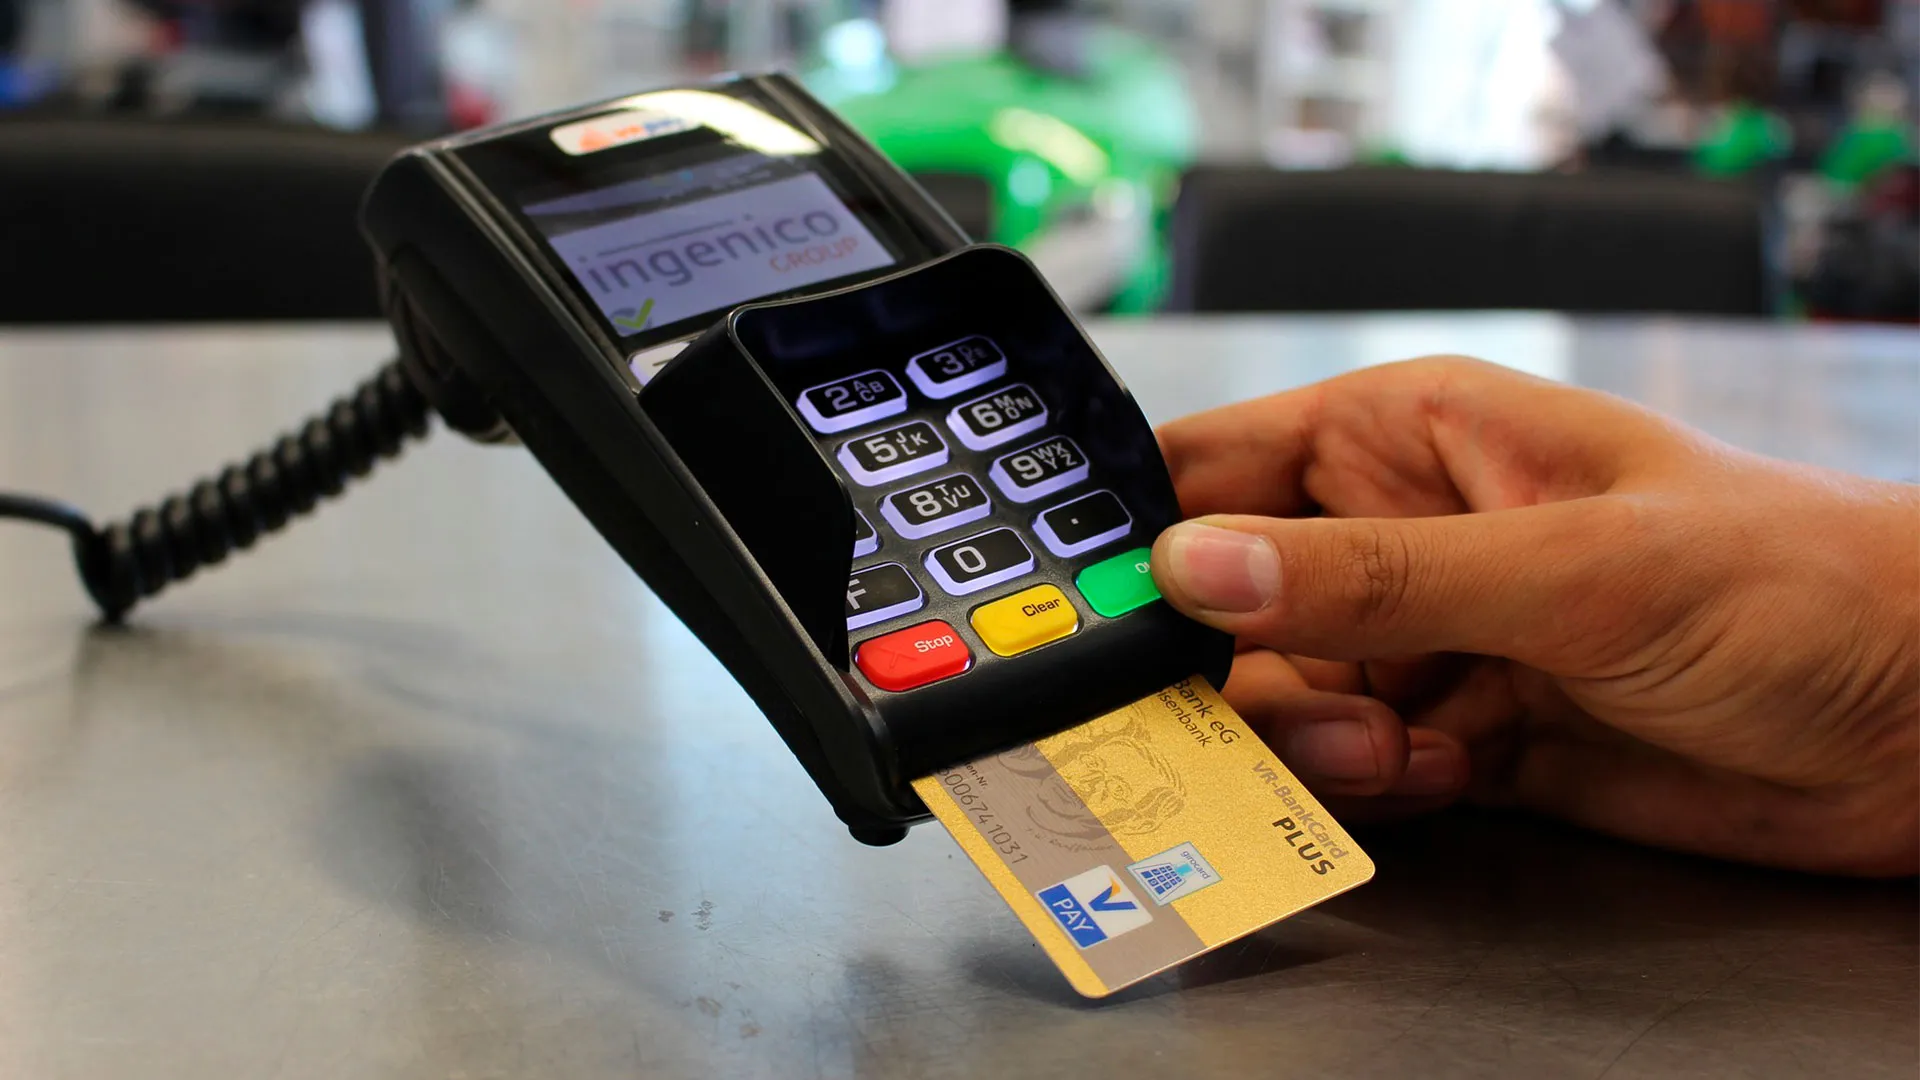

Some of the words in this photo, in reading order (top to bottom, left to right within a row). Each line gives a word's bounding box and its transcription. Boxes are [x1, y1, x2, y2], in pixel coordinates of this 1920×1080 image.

[578, 211, 839, 287] ingenico
[769, 236, 858, 274] GROUP
[933, 351, 964, 376] 3
[824, 386, 857, 411] 2
[971, 403, 1002, 428] 6
[865, 437, 899, 463] 5
[1011, 454, 1044, 480] 9
[909, 490, 942, 517] 8
[1135, 561, 1150, 574] O
[1022, 598, 1060, 617] Clear
[914, 634, 954, 654] Stop
[1209, 720, 1241, 745] eG
[1252, 760, 1349, 859] VR-BankCard
[1272, 816, 1335, 876] PLUS
[1180, 850, 1211, 880] girocard
[1052, 898, 1094, 932] PAY
